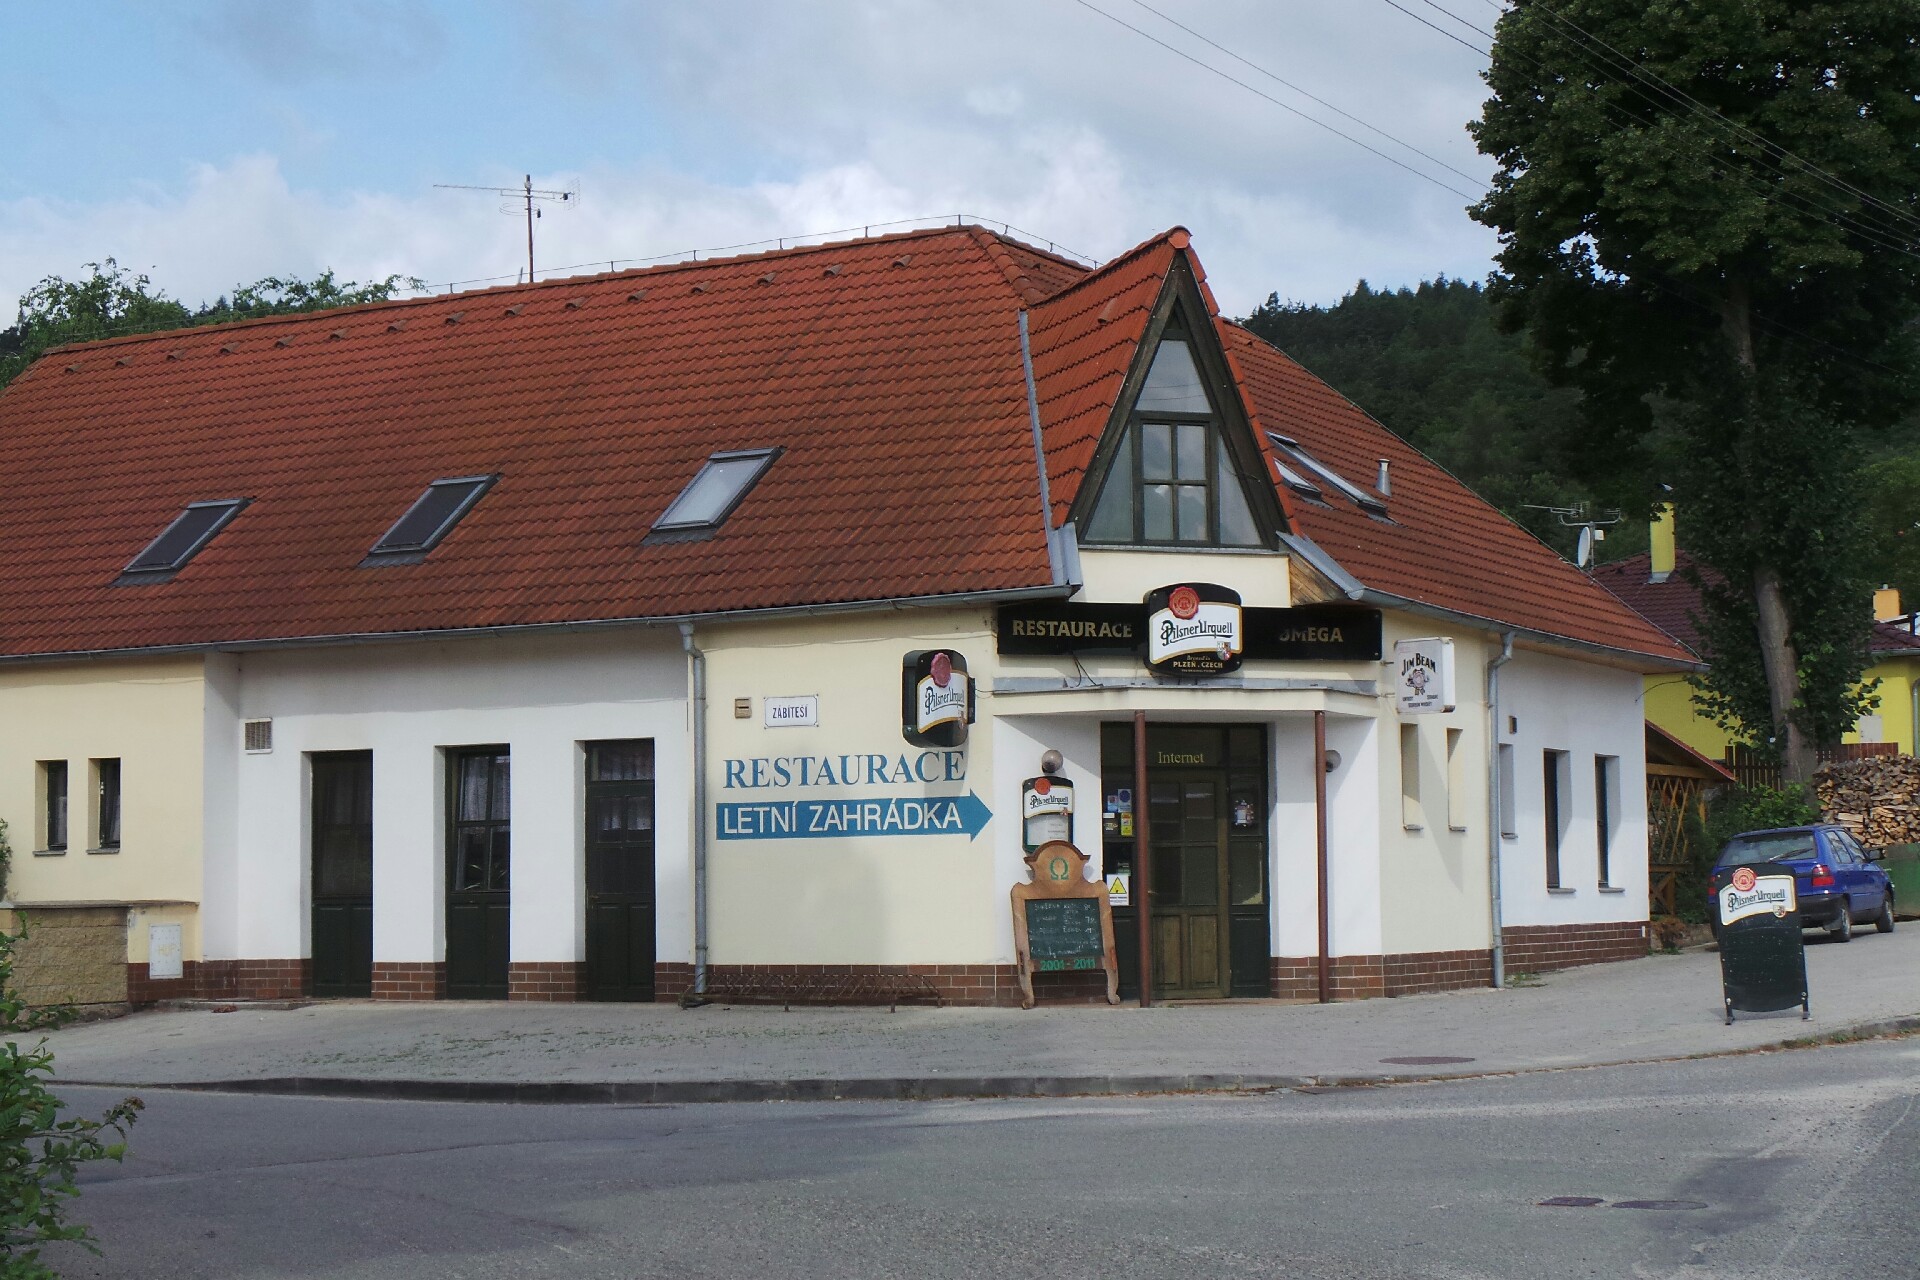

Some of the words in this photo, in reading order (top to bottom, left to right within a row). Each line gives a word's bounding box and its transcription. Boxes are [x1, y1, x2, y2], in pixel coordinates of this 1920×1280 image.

[1012, 620, 1133, 638] RESTAURACE
[1161, 620, 1200, 647] Pilsner
[1199, 620, 1233, 639] Urquell
[1402, 657, 1415, 676] JIM
[1416, 653, 1436, 673] BEAM
[925, 686, 950, 716] Pilsner
[723, 751, 966, 789] RESTAURACE
[1158, 752, 1205, 764] Internet
[724, 801, 797, 834] LETNÍ
[809, 798, 962, 832] ZAHRÁDKA
[1728, 892, 1757, 913] Pilsner
[1756, 889, 1785, 903] Urquell
